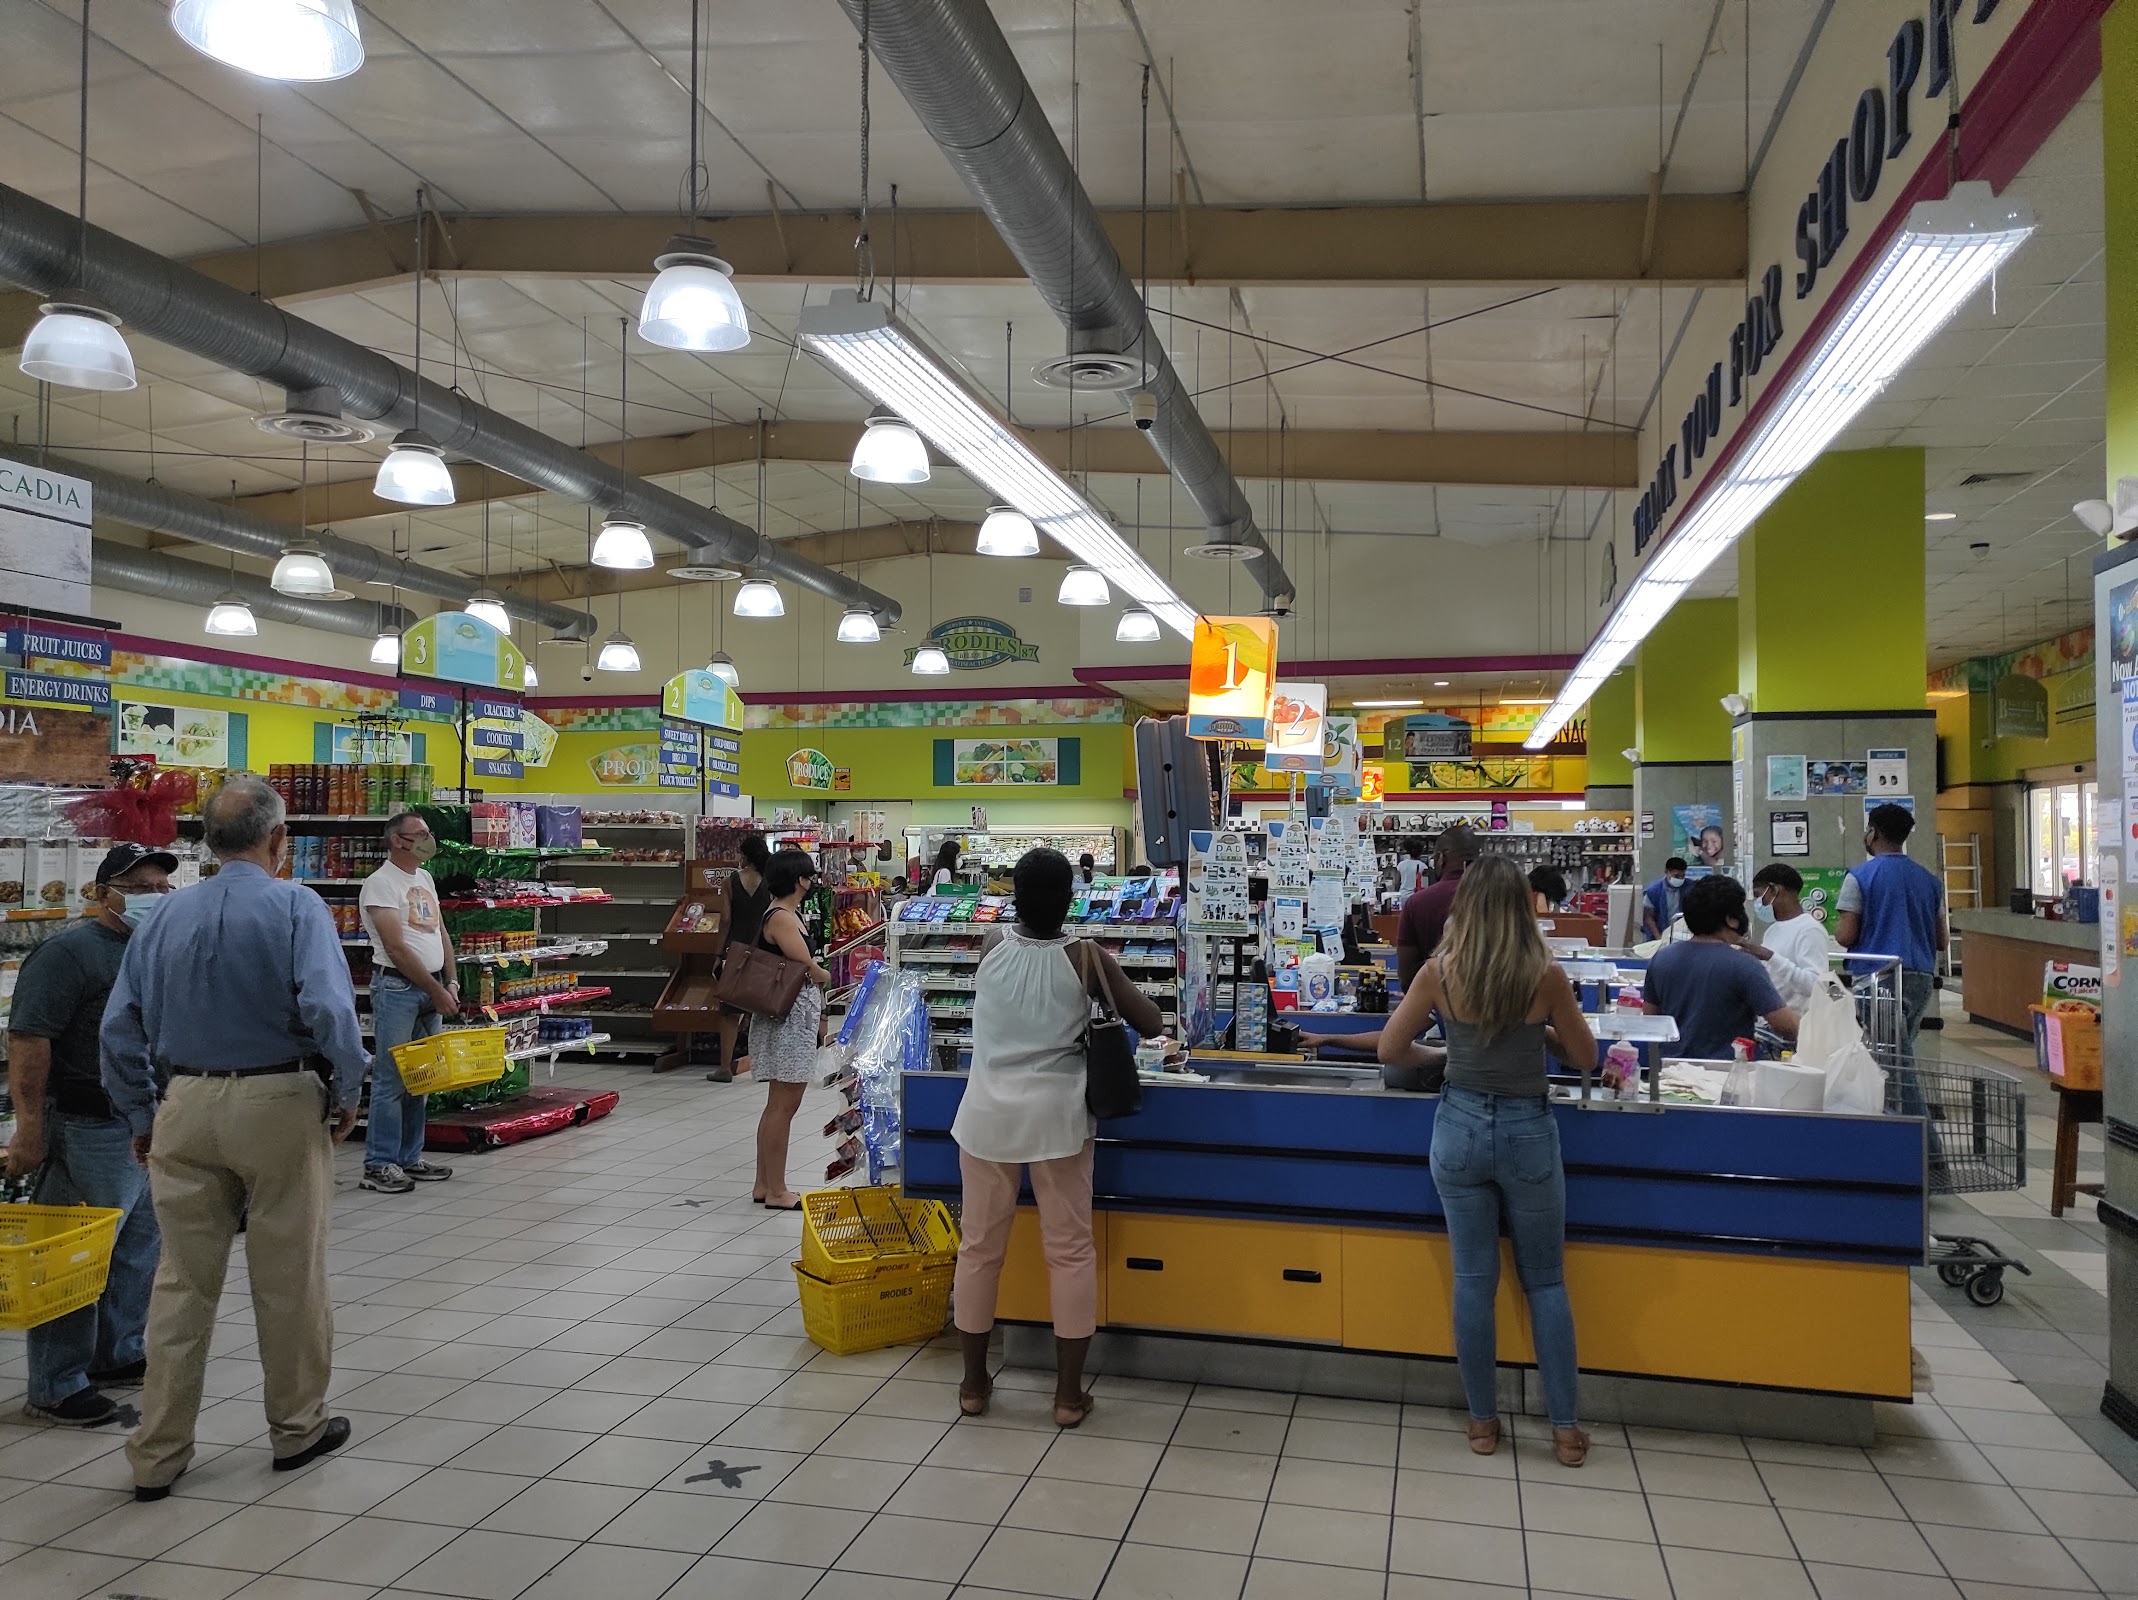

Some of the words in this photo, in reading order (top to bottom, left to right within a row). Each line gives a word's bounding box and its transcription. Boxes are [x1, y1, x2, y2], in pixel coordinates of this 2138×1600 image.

[1633, 443, 1677, 557] THANK
[1682, 362, 1722, 479] YOU
[1729, 264, 1784, 407] FOR
[1796, 0, 2000, 299] SHOPP
[0, 469, 81, 509] CADIA
[23, 634, 61, 654] FRUIT
[62, 639, 102, 660] JUICES
[415, 635, 427, 664] 3
[940, 634, 1017, 654] RODIES
[1022, 648, 1034, 658] 87
[504, 653, 515, 680] 2
[1219, 641, 1241, 690] 1
[11, 676, 62, 698] ENERGY
[63, 682, 108, 703] DRINKS
[672, 686, 680, 708] 2
[420, 695, 436, 708] DIPS
[484, 704, 515, 719] CRACKERS
[730, 702, 736, 722] 1
[1286, 700, 1307, 736] 2
[486, 732, 513, 746] COOKIES
[664, 728, 680, 741] SWEET
[680, 731, 694, 744] BREAD
[1324, 729, 1340, 759] 3
[1388, 738, 1402, 750] 12
[672, 752, 688, 764] BREAD
[488, 762, 512, 776] SNACKS
[793, 761, 829, 780] PRODUCE
[660, 774, 676, 786] FLOUR
[720, 783, 731, 794] MILK
[1364, 775, 1375, 793] 5
[1216, 844, 1242, 852] DAD
[2054, 976, 2101, 990] CORN
[875, 1262, 911, 1274] BRODIES
[880, 1286, 913, 1300] BRODIES
